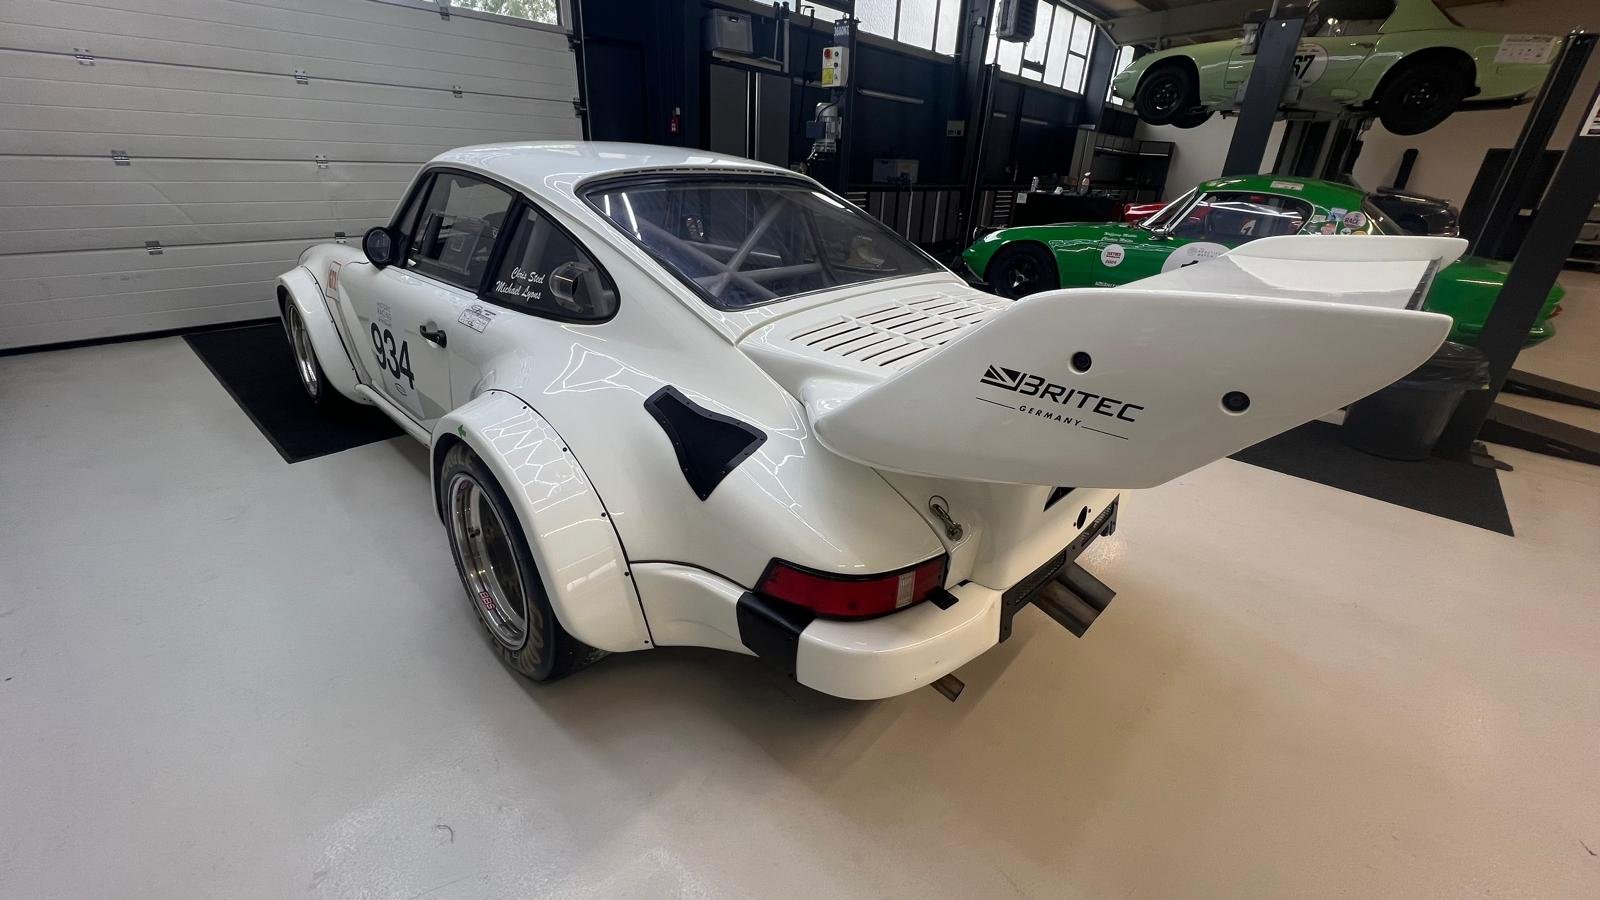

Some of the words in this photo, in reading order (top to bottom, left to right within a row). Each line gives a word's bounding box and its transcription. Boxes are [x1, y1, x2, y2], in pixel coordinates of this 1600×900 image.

[511, 266, 528, 280] Chris
[495, 280, 521, 296] Michael
[521, 285, 542, 302] Lyons
[371, 322, 415, 390] 934
[1015, 372, 1145, 423] BRITEC
[1019, 405, 1082, 427] GERMANY
[480, 591, 497, 612] BBS
